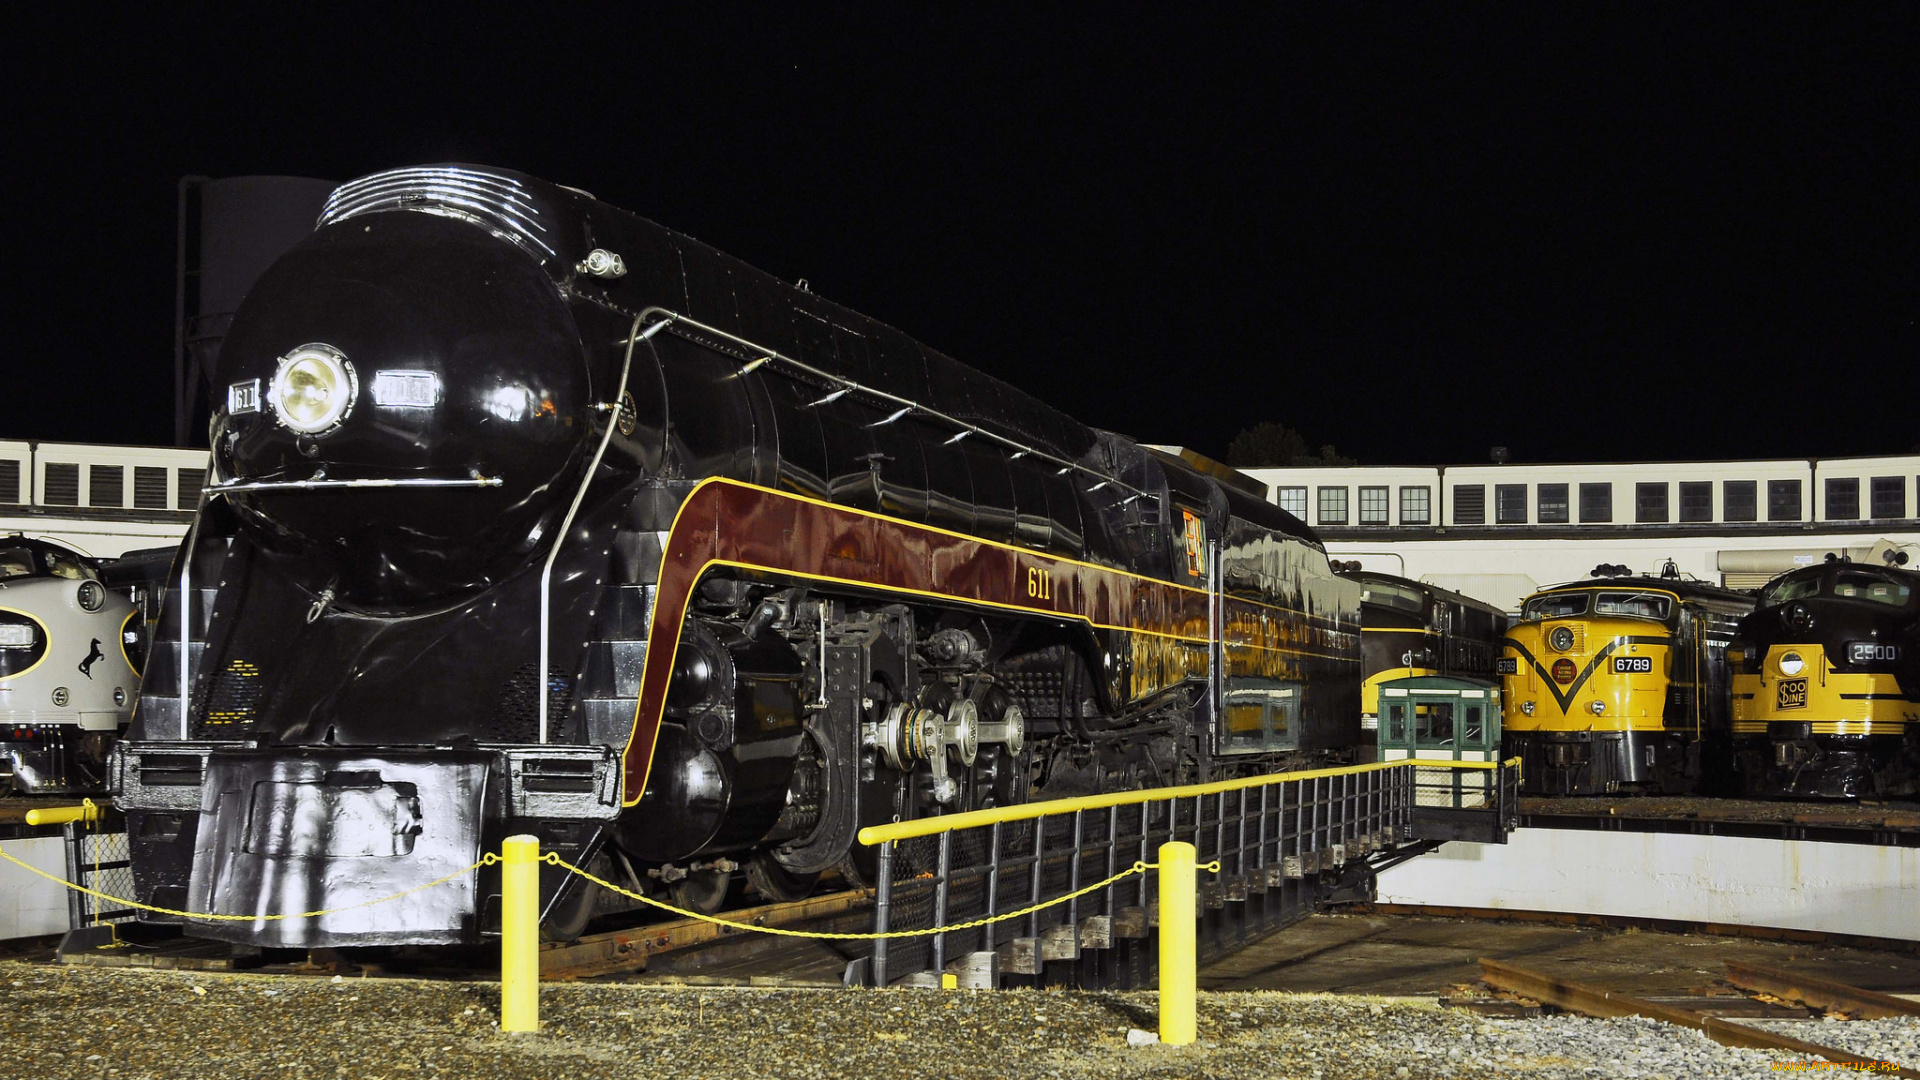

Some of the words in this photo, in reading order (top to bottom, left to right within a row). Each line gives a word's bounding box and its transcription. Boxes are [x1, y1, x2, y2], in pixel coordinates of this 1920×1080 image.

[236, 387, 255, 409] 611
[1028, 566, 1050, 600] 611
[1853, 644, 1895, 660] 2500
[1498, 660, 1515, 672] 6789
[1616, 659, 1650, 671] 6789
